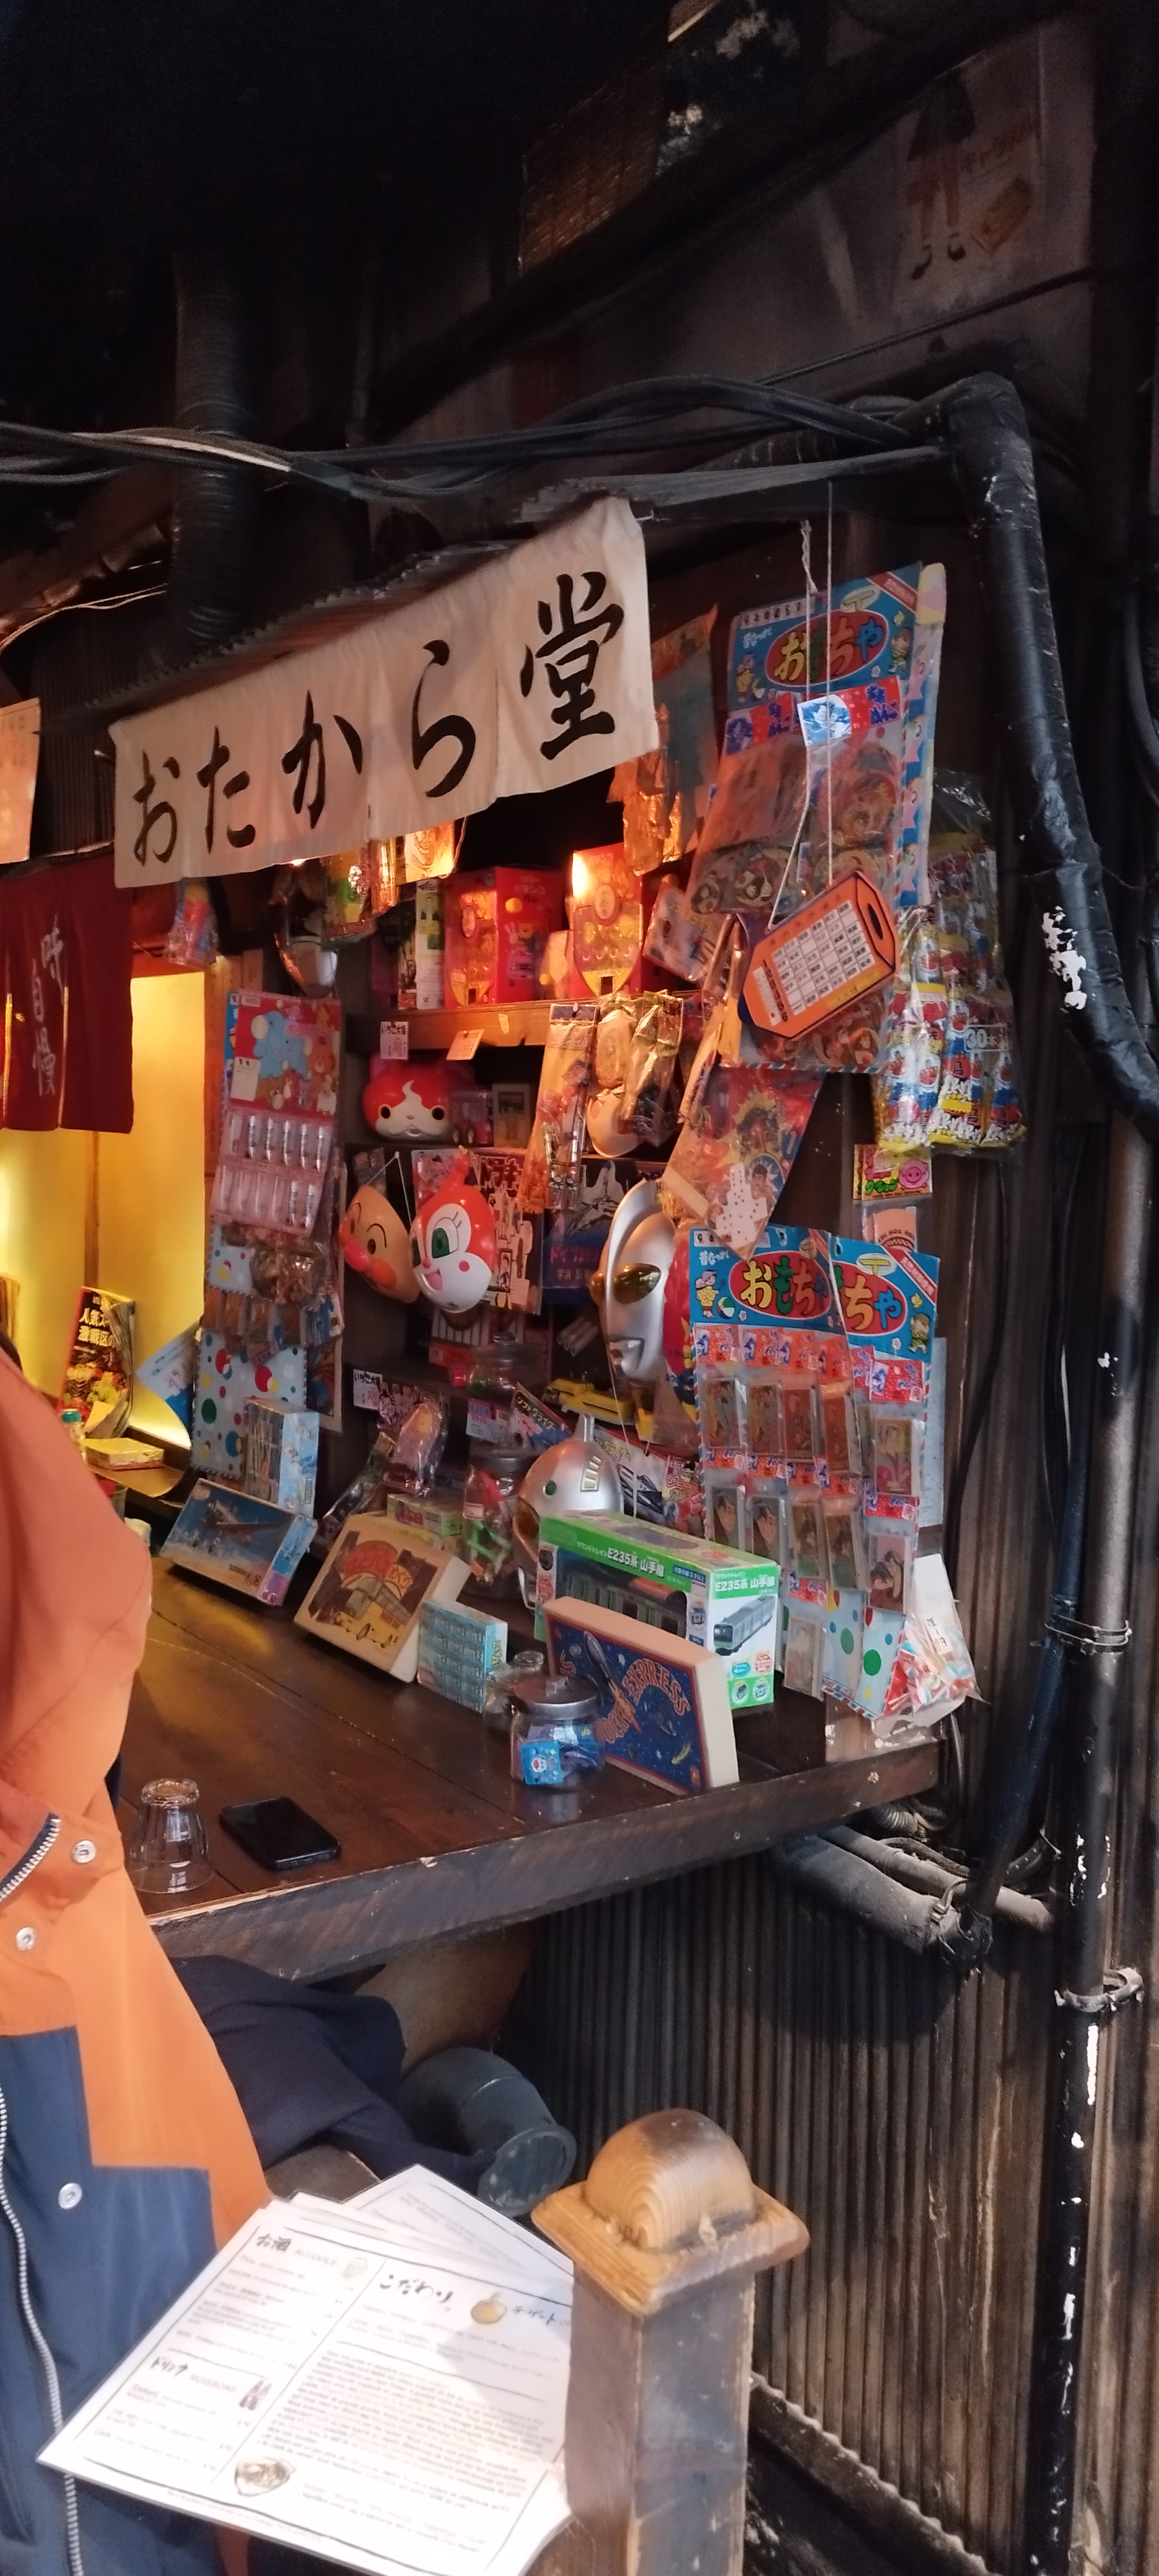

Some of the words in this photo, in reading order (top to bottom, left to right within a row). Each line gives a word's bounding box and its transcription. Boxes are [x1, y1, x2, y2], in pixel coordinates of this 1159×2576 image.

[133, 570, 625, 866] おたから堂
[740, 1255, 829, 1315] おもちゃ
[622, 1658, 691, 1716] EXPRESS
[256, 2233, 292, 2253] お酒
[377, 2273, 453, 2307] こだわり
